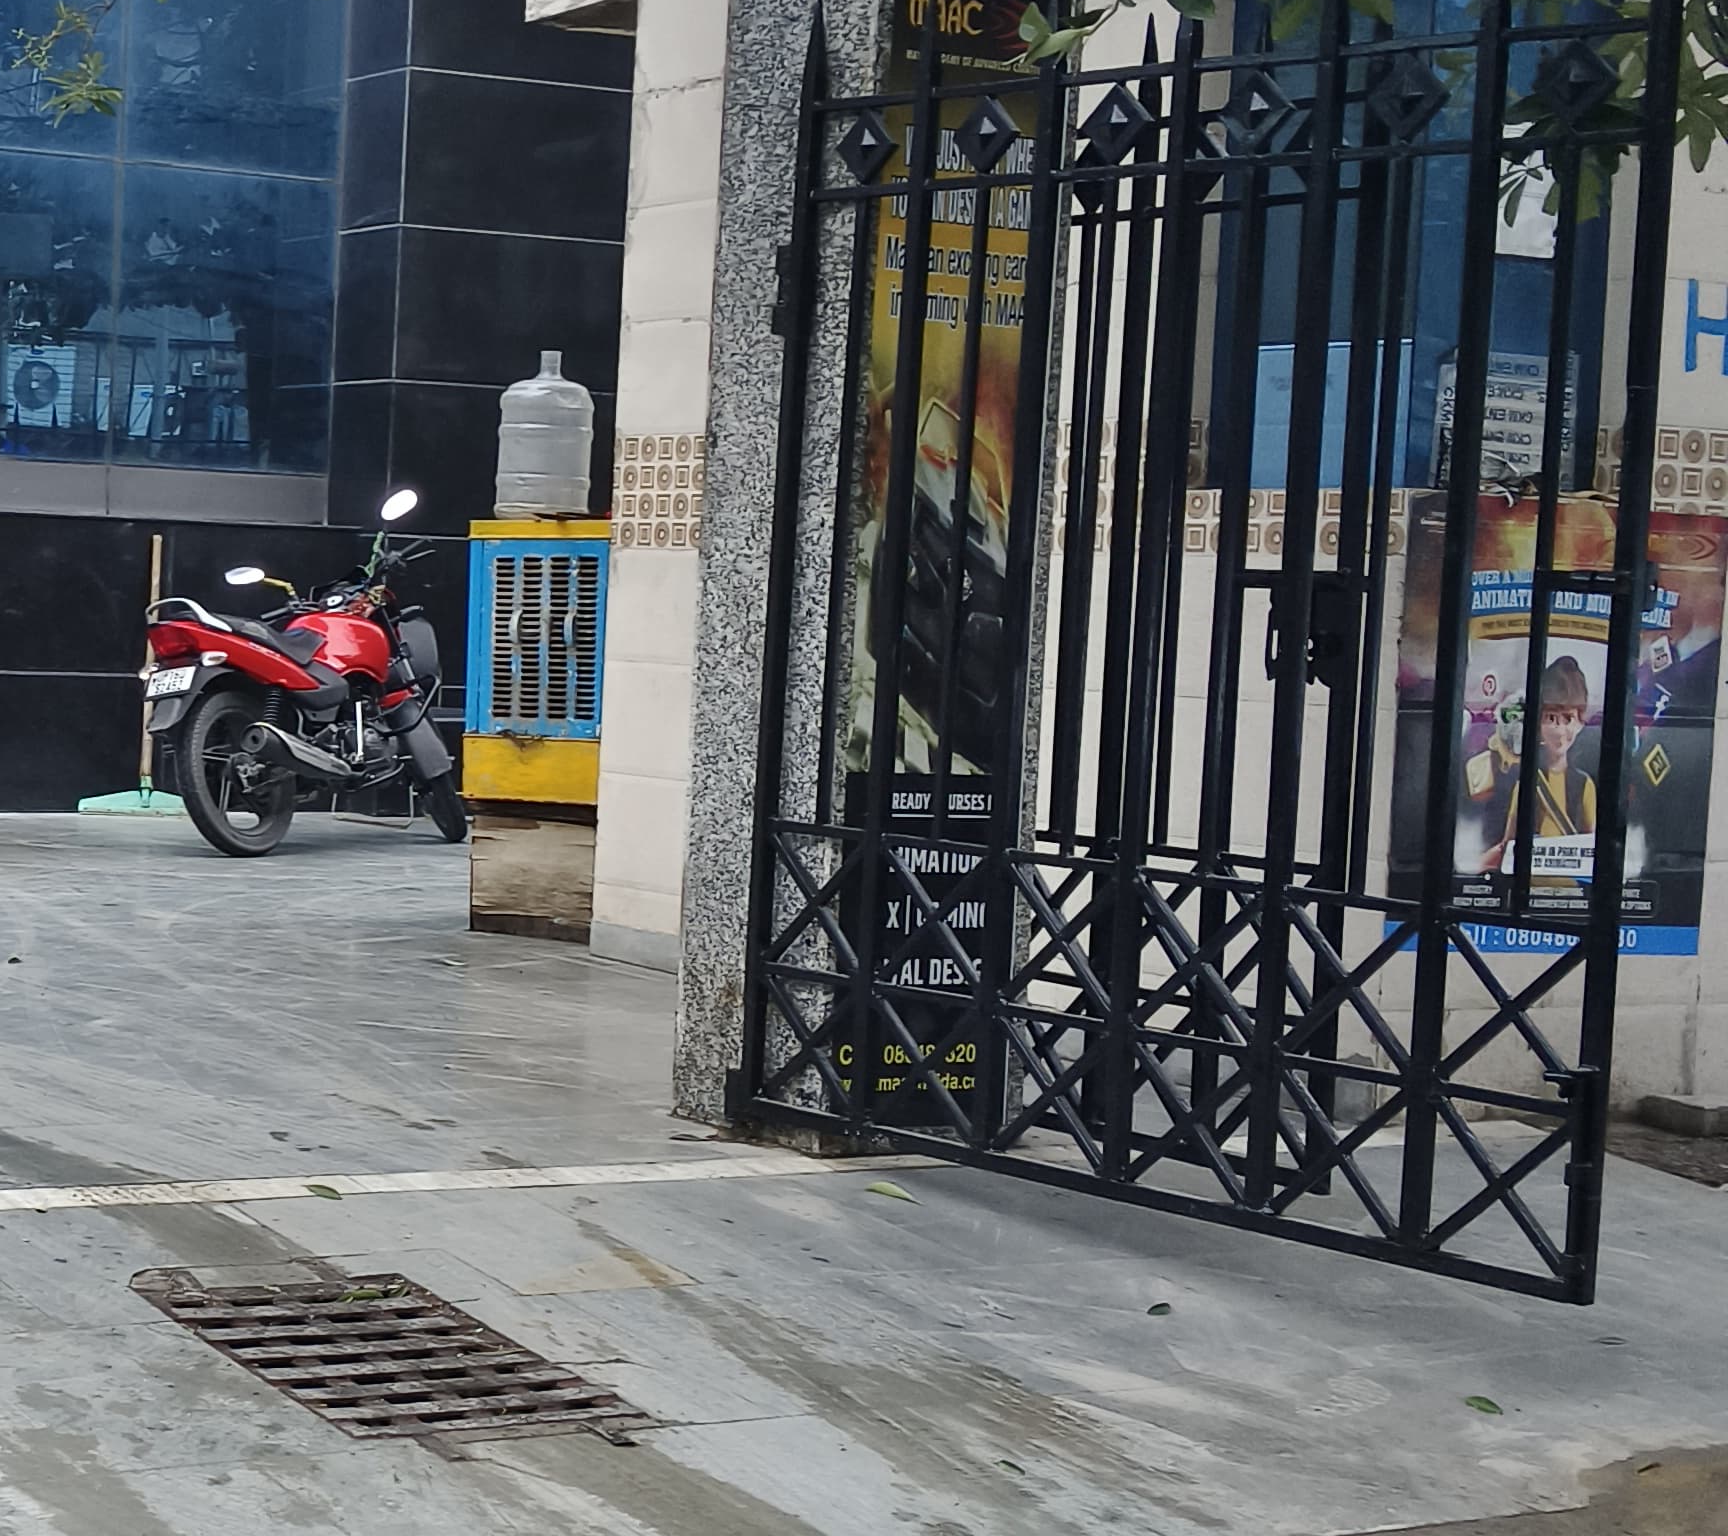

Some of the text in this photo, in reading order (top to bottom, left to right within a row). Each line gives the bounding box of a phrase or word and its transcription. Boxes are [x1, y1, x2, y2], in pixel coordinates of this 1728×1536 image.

[1555, 590, 1583, 610] AND
[891, 792, 932, 810] READY
[948, 793, 985, 811] URSES
